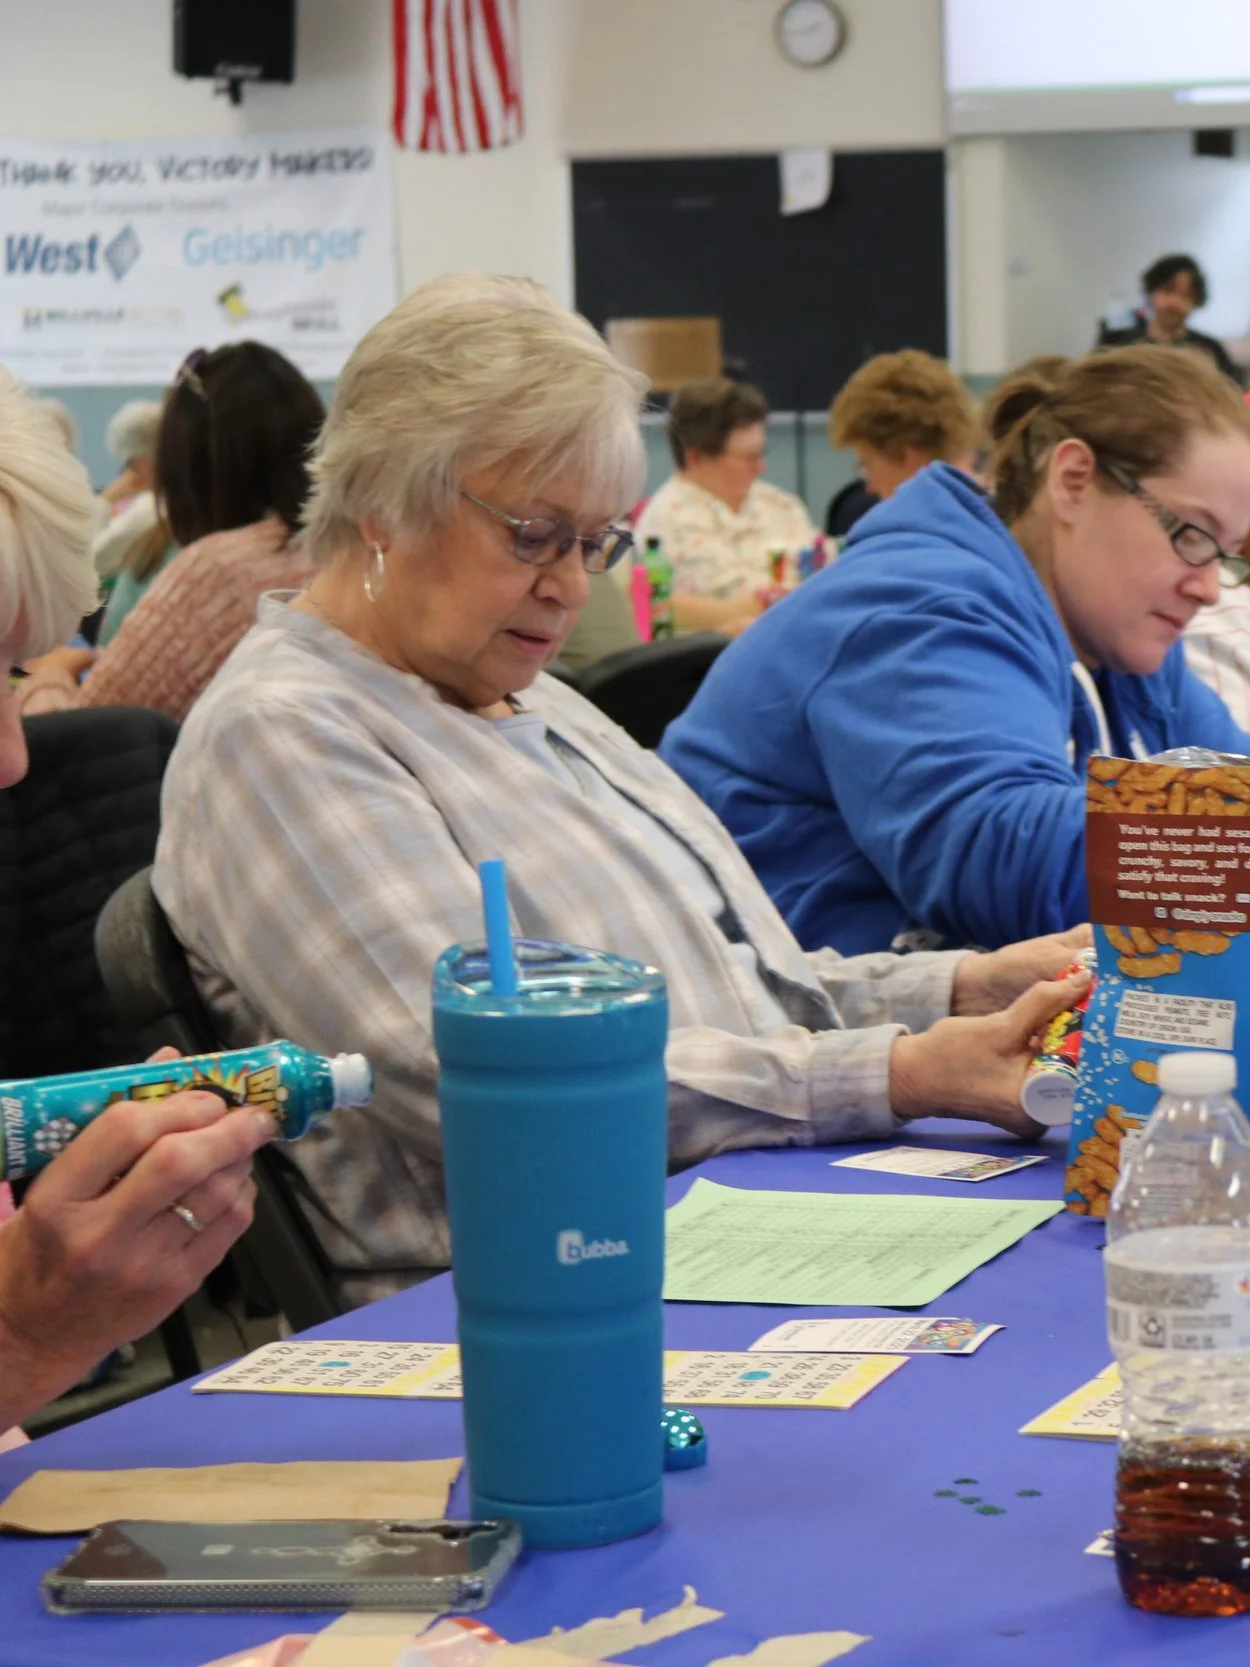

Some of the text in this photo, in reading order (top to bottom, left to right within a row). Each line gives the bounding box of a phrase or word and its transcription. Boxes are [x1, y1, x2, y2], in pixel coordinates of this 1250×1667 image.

[5, 223, 366, 274] West Geisinger
[1119, 824, 1160, 835] You've
[1163, 828, 1194, 836] never
[1197, 826, 1221, 837] had
[1118, 841, 1148, 852] open
[1149, 841, 1170, 851] this
[1171, 841, 1192, 854] bag
[1193, 842, 1215, 852] and
[1216, 844, 1236, 853] see
[1118, 855, 1164, 869] crunchy,
[1169, 858, 1209, 870] savory,
[1214, 858, 1238, 869] and
[1117, 870, 1226, 886] satisfy that craving!
[1116, 889, 1227, 903] Want to talk snack?
[1, 1096, 27, 1165] BRILLIANT
[557, 1229, 630, 1265] bubba
